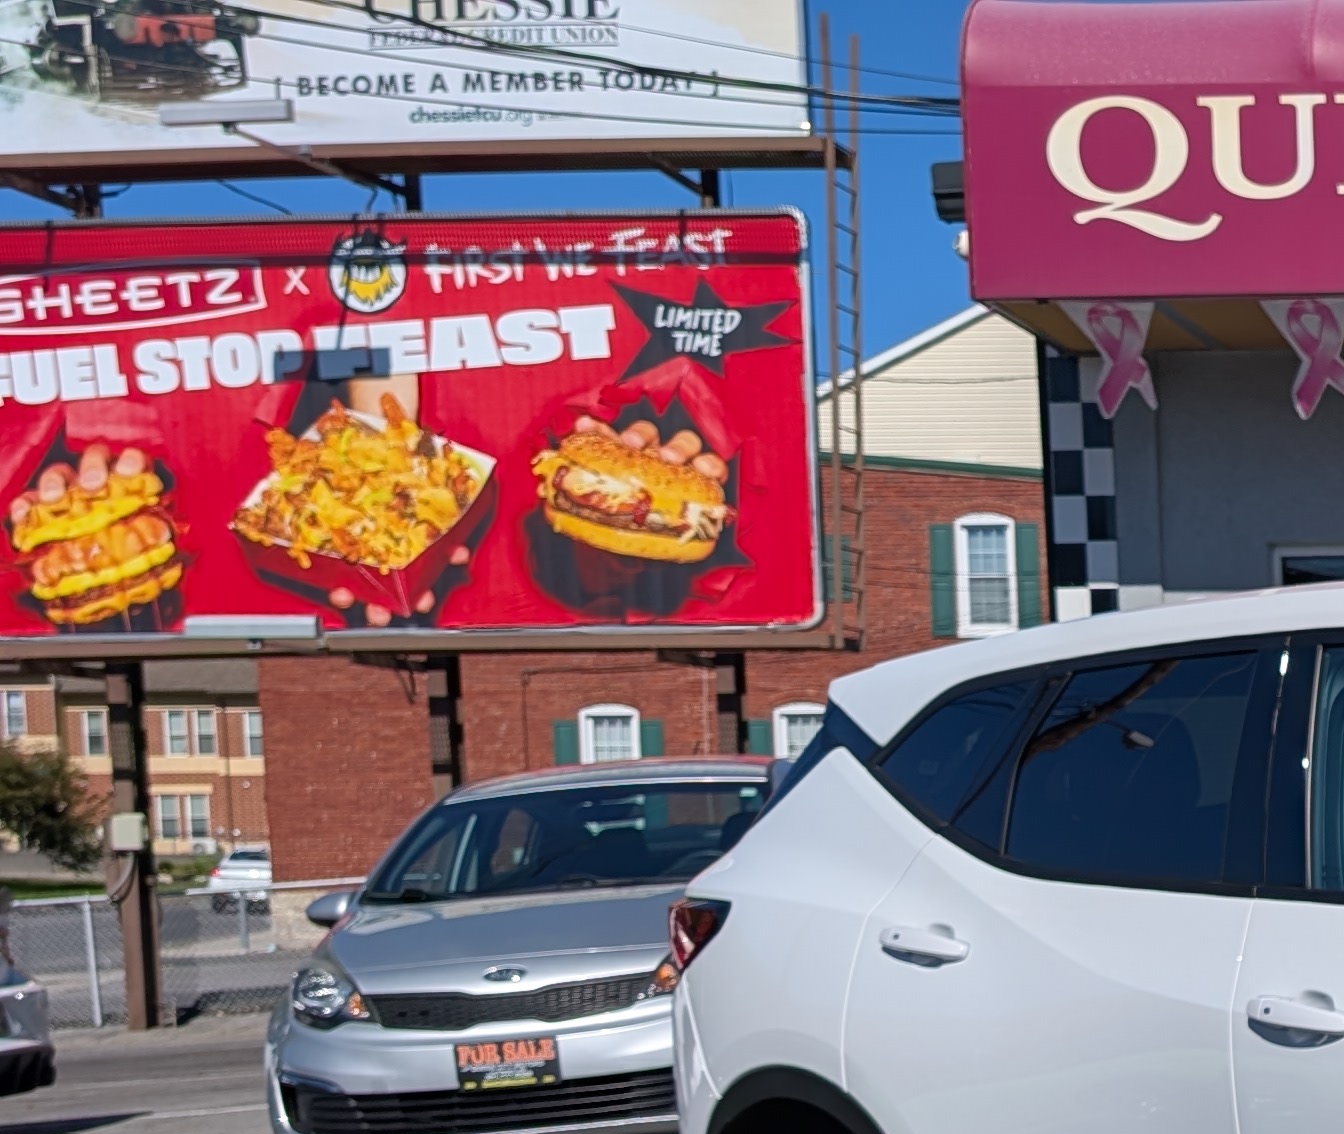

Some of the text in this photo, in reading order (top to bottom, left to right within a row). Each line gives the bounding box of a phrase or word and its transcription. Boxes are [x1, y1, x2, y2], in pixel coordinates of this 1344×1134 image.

[550, 26, 618, 43] UNION
[298, 73, 416, 97] BECOME
[428, 72, 449, 95] A
[462, 70, 585, 94] MEMBER
[599, 69, 697, 92] TODAY
[424, 227, 734, 294] FIRST WE FEAST
[0, 268, 244, 323] SHEETZ
[654, 304, 743, 334] LIMITED
[0, 304, 616, 406] UEL STOP FEAST
[671, 330, 724, 357] TIME
[457, 1044, 500, 1067] FOR
[503, 1038, 556, 1062] SALE
